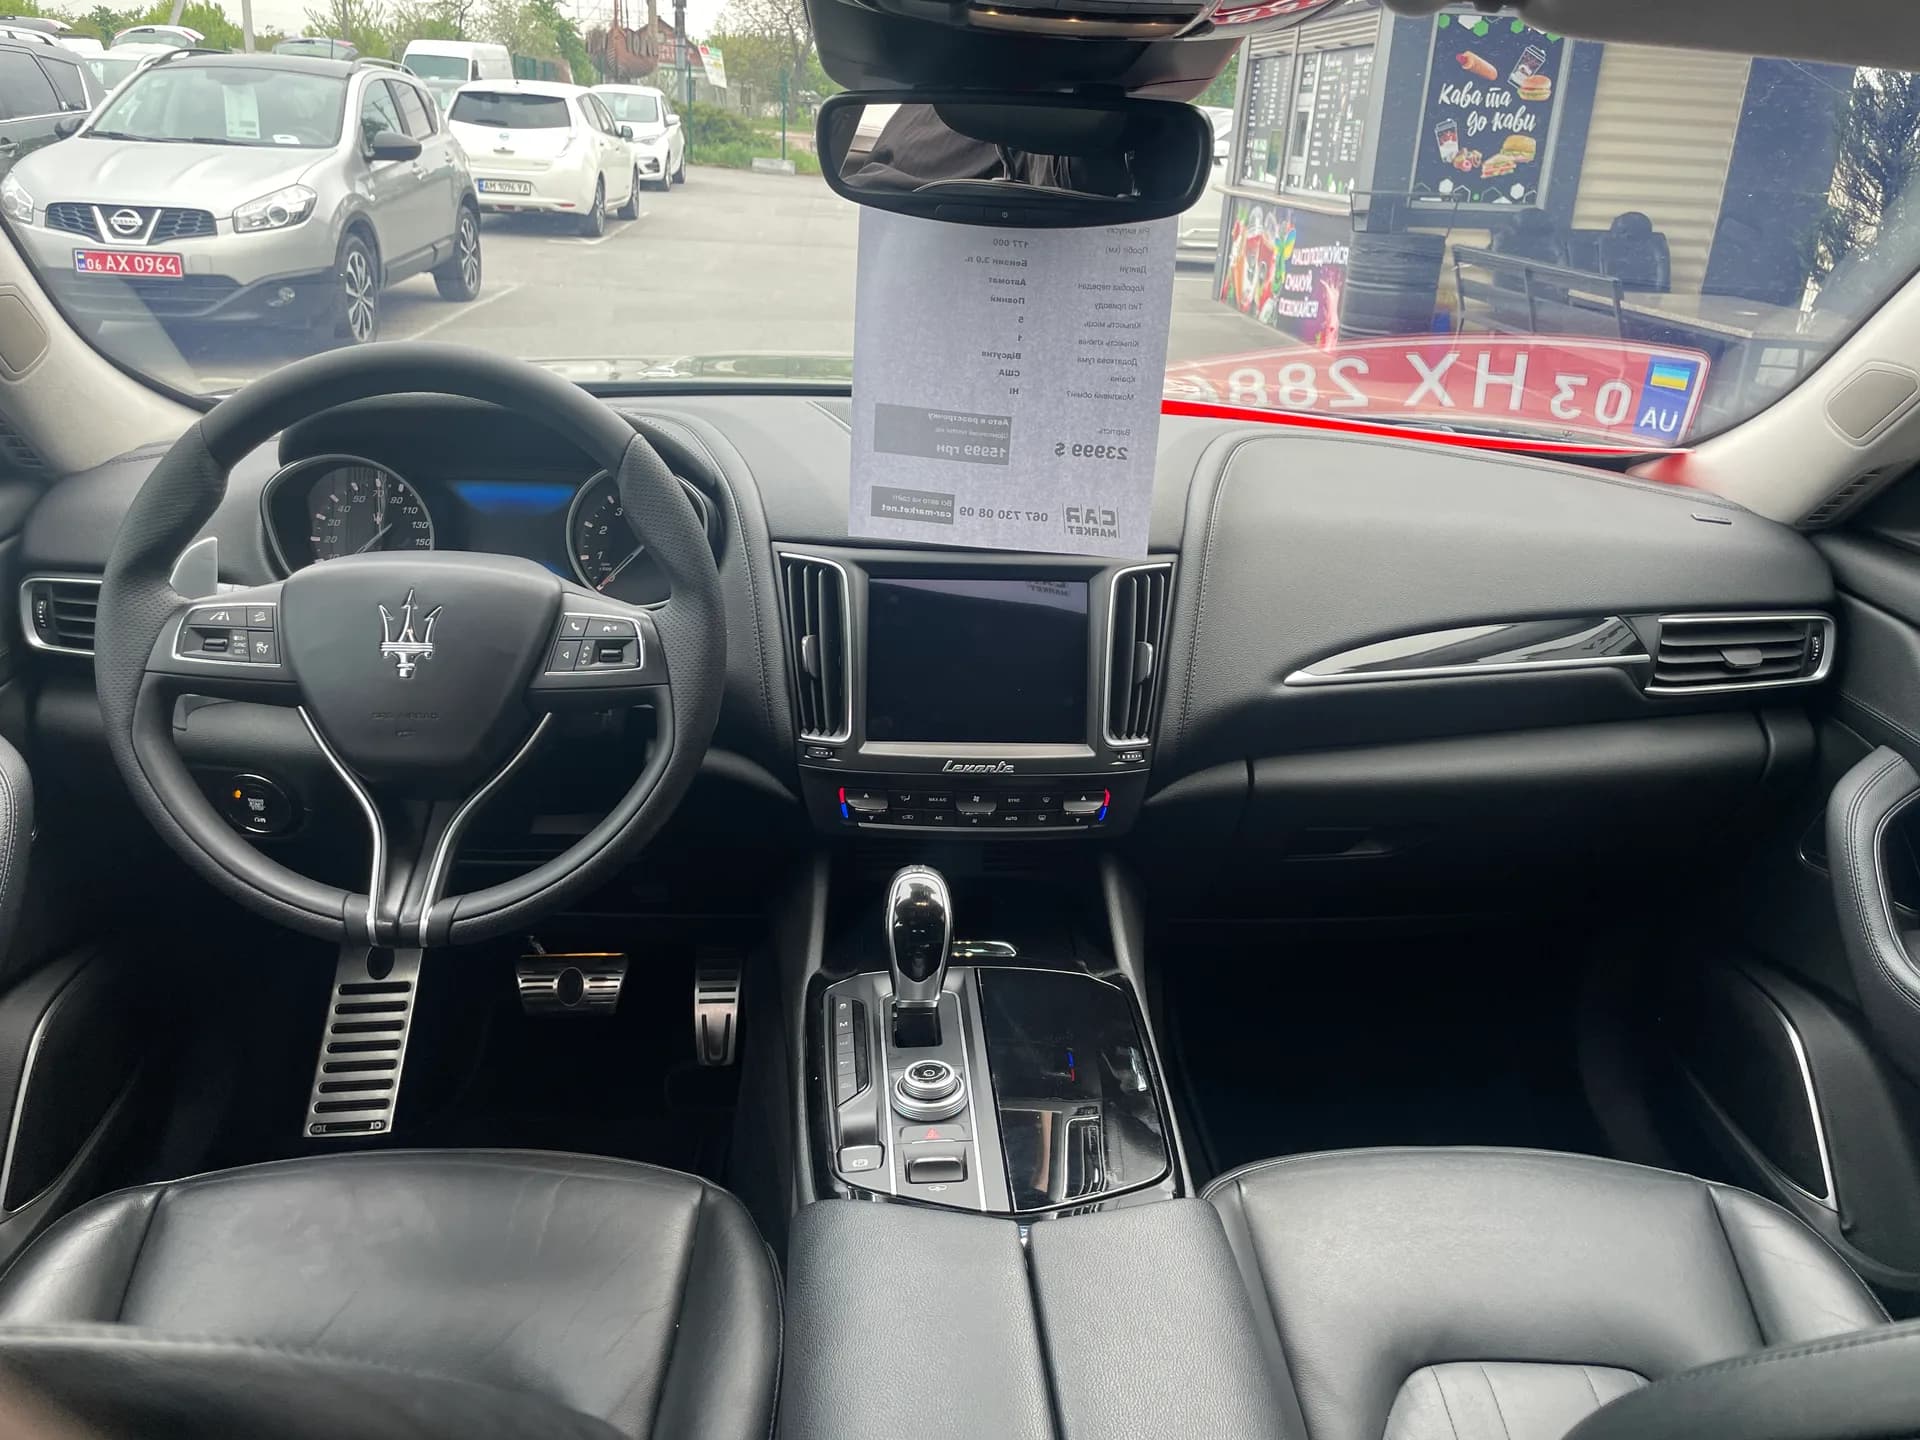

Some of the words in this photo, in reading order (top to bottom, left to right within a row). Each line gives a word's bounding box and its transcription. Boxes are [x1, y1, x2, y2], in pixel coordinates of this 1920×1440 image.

[1439, 80, 1482, 108] Кава
[1485, 88, 1512, 108] та
[1467, 110, 1488, 136] до
[1492, 105, 1536, 132] кави
[87, 258, 102, 271] 06
[106, 255, 130, 272] AX
[134, 256, 176, 274] 0964
[352, 495, 366, 504] 50
[336, 505, 352, 513] 40
[402, 506, 419, 514] 110
[614, 507, 624, 517] 3
[327, 519, 342, 527] 30
[412, 521, 430, 530] 130
[599, 525, 608, 535] 2
[324, 536, 338, 544] 20
[416, 538, 431, 546] 150
[598, 551, 604, 560] 1
[942, 760, 1015, 774] Levante
